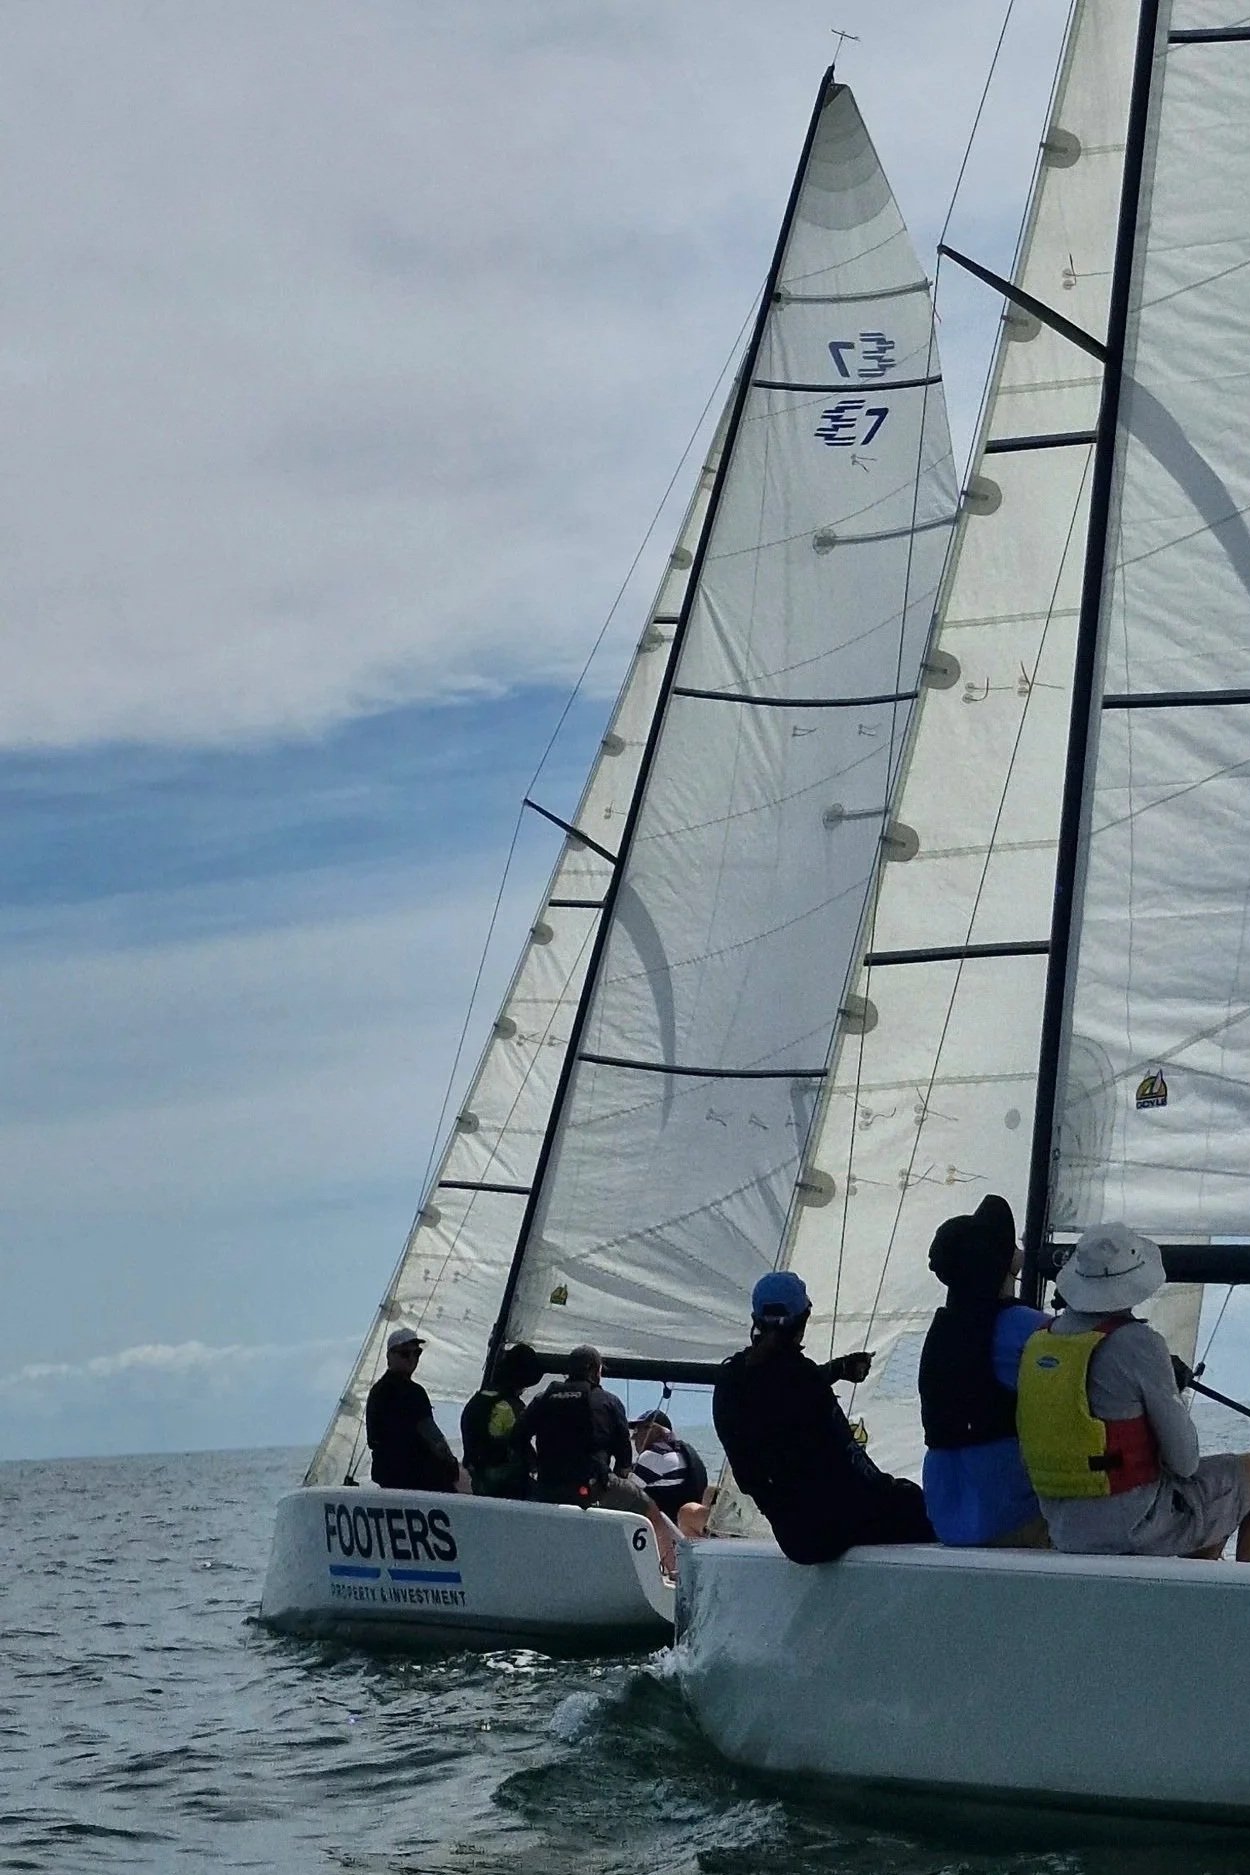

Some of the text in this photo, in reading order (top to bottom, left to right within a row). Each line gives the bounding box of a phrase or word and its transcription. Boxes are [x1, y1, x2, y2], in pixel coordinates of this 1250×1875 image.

[324, 1502, 458, 1562] FOOTERS
[632, 1527, 648, 1551] 6
[330, 1582, 376, 1600] PROPERTY
[389, 1587, 466, 1607] INVESTMENT
